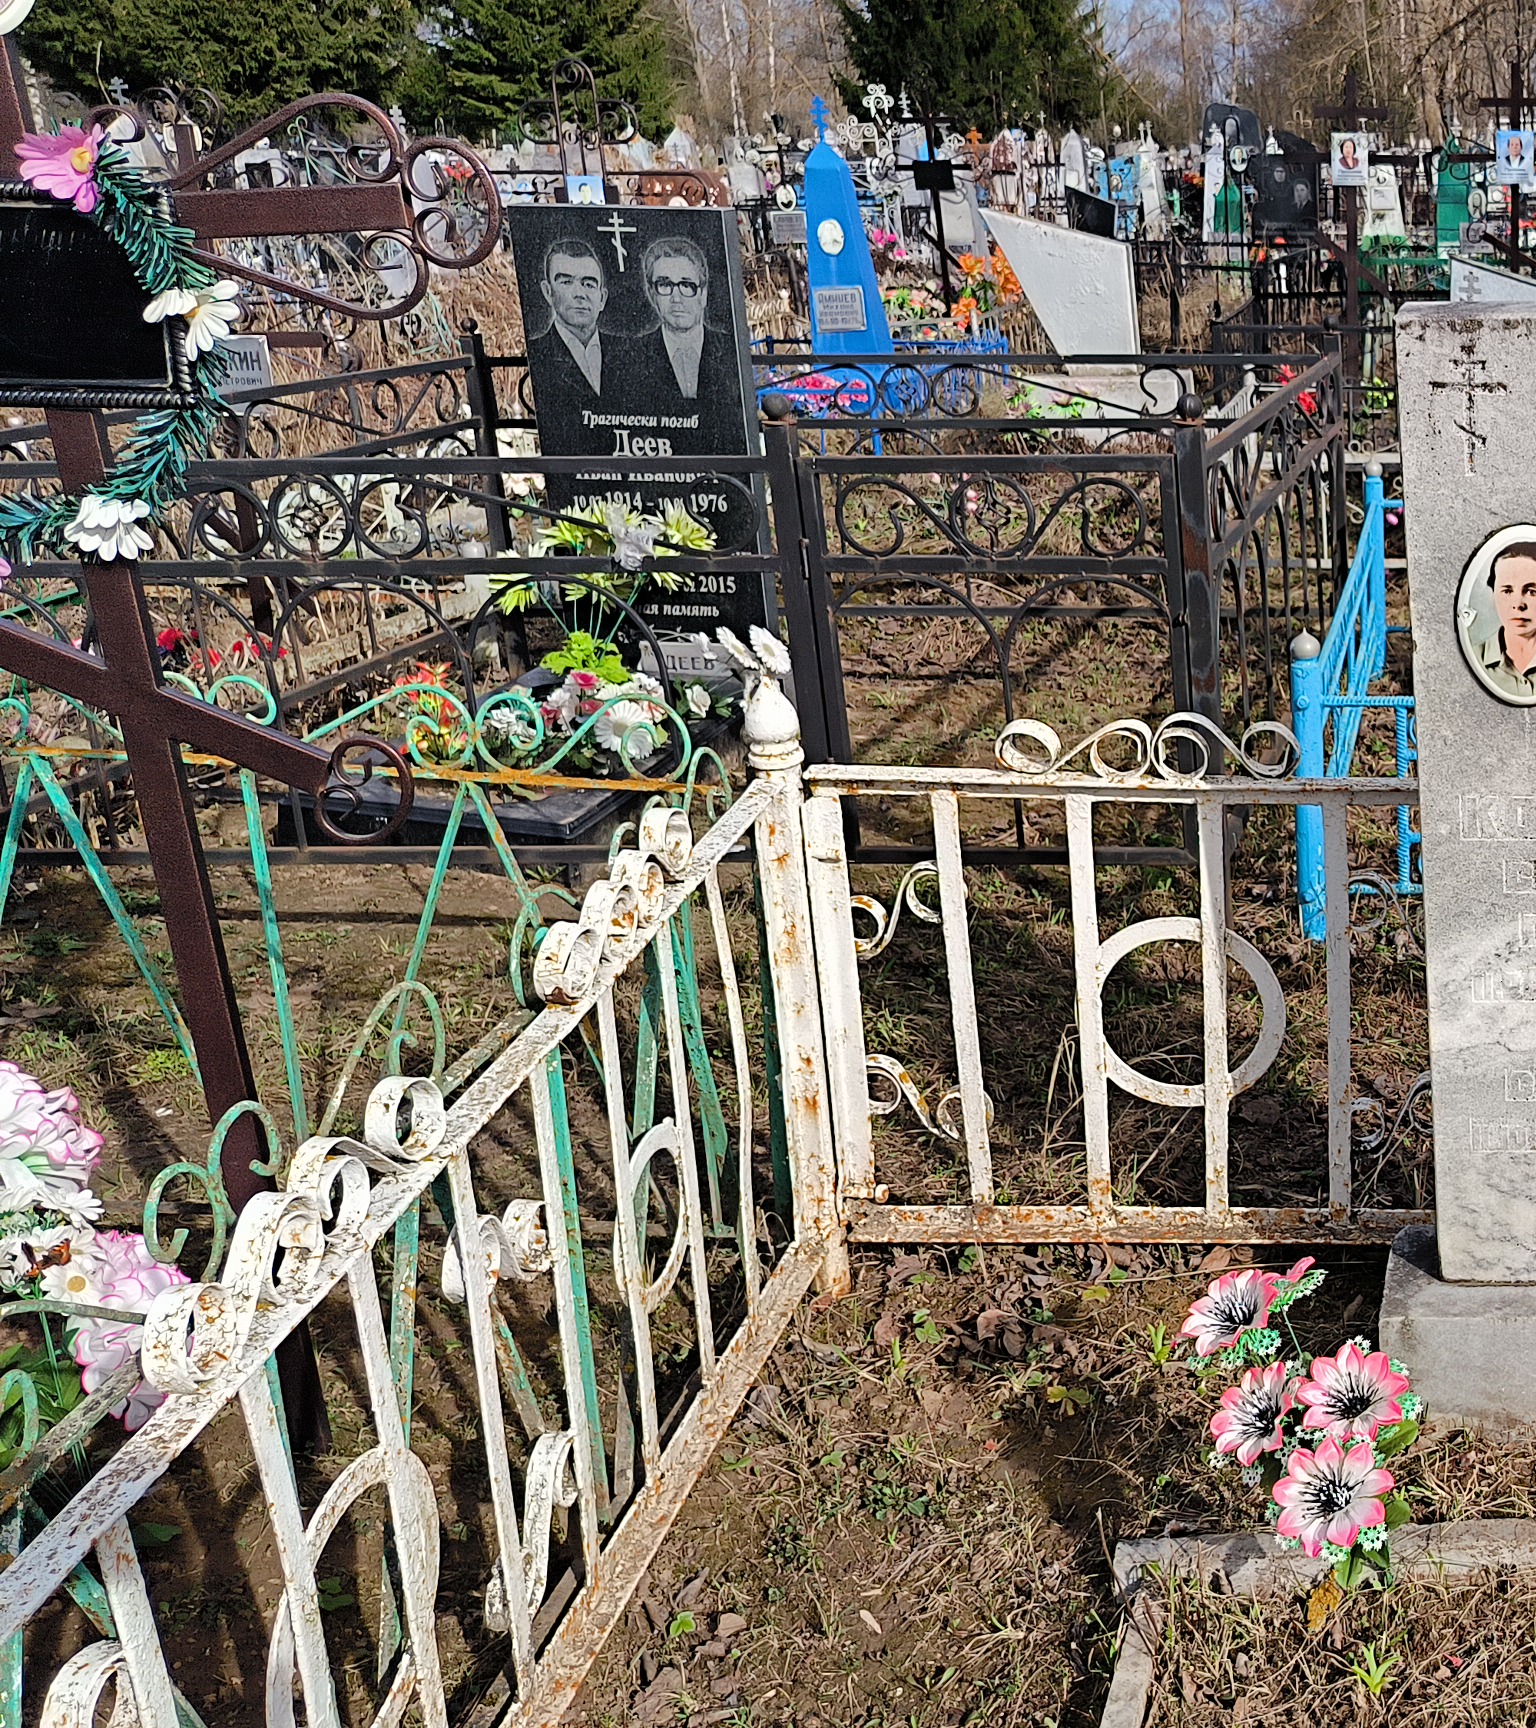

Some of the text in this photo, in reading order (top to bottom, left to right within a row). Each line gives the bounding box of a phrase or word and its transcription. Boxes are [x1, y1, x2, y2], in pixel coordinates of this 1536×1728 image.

[582, 410, 700, 428] Трагически погиб
[612, 429, 673, 457] Деев
[690, 494, 728, 513] 1976
[698, 575, 737, 594] 2015
[663, 604, 720, 617] память
